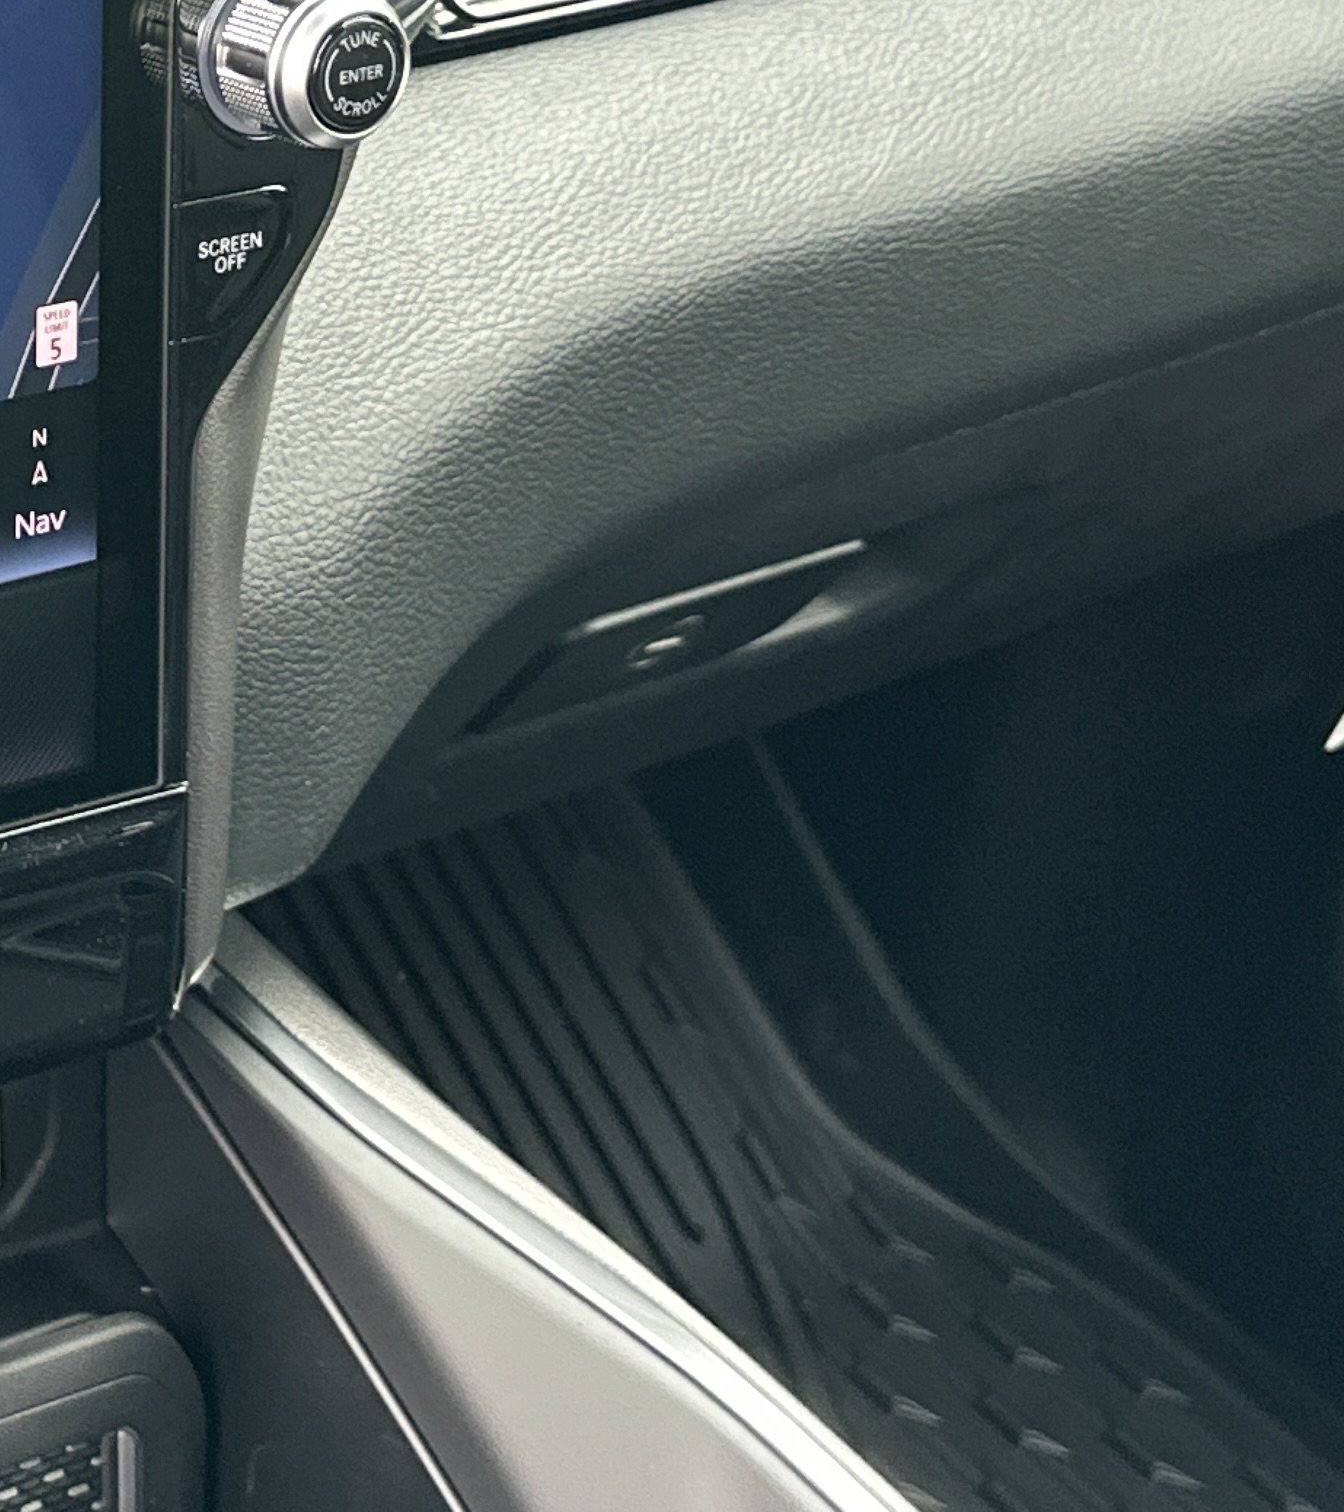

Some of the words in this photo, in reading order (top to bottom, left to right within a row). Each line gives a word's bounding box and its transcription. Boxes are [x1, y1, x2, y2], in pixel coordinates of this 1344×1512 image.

[340, 30, 381, 53] TUNE
[339, 63, 384, 86] ENTER
[333, 90, 388, 117] SCROLL
[198, 230, 263, 260] SCREEN
[214, 252, 247, 274] OFF
[50, 336, 62, 361] 5
[32, 427, 47, 448] N
[15, 508, 67, 540] Nav
